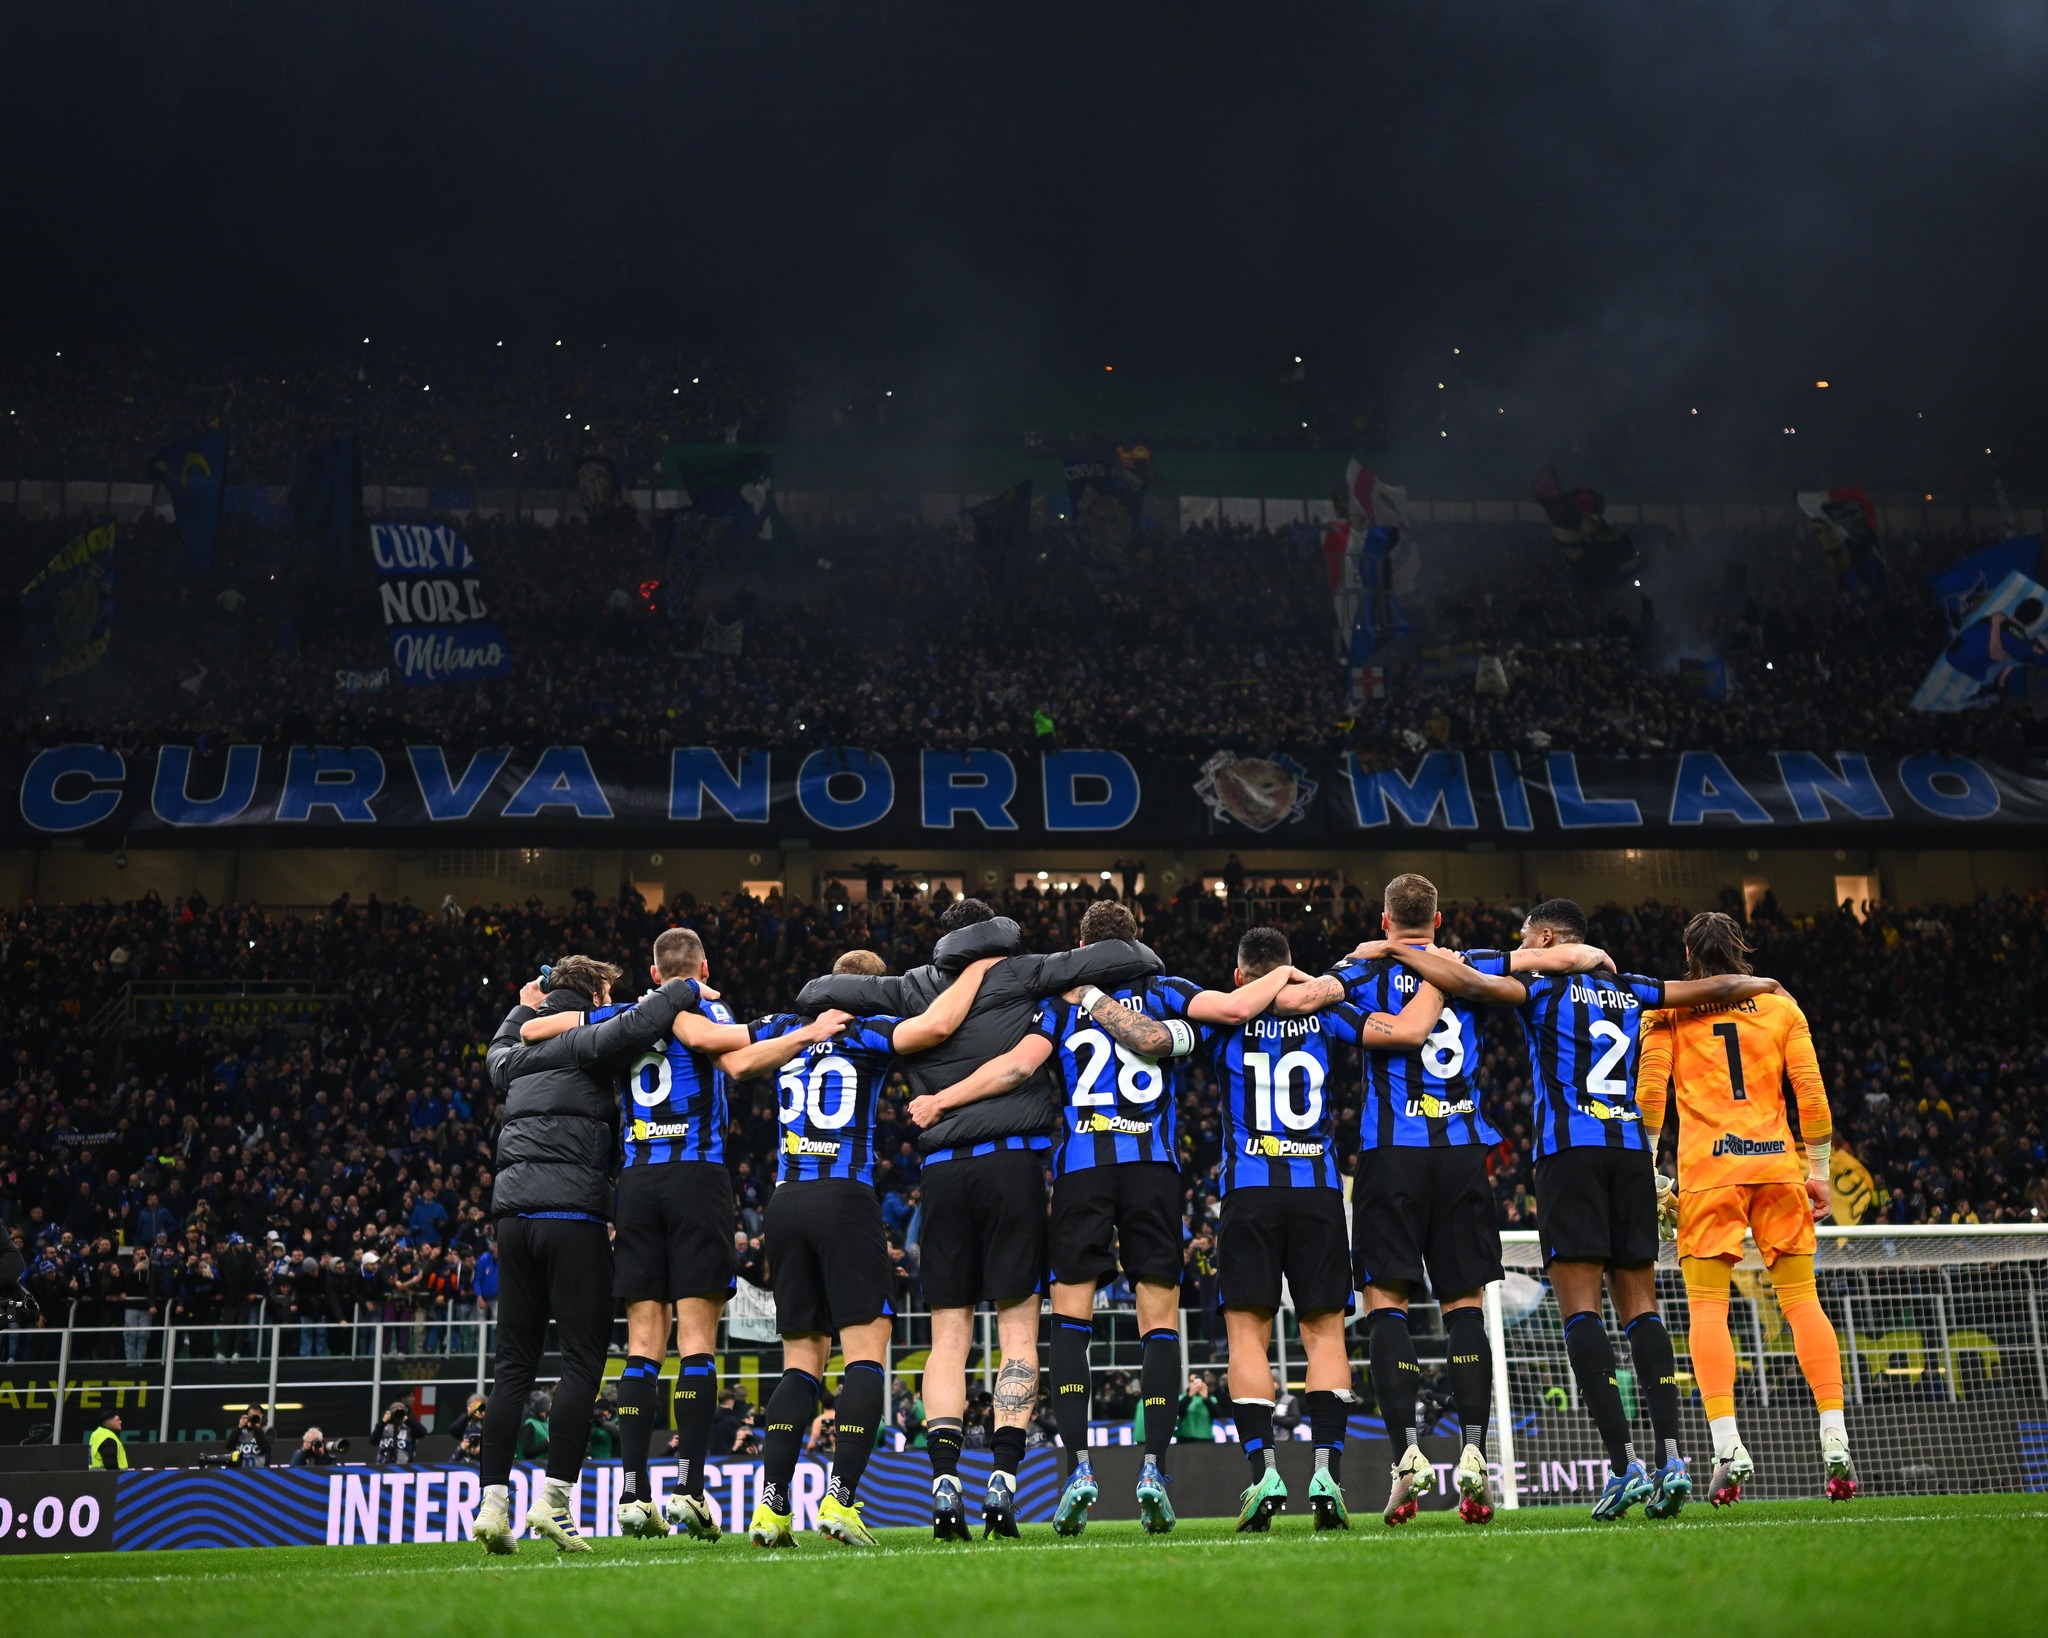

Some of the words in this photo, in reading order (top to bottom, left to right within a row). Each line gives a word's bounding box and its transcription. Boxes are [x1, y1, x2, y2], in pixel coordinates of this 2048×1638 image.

[394, 633, 506, 680] Milano
[20, 743, 614, 832] CURVA
[669, 747, 1141, 831] NORD
[1349, 750, 2001, 829] MILANO
[1244, 1015, 1321, 1039] LAUTARO
[1421, 1007, 1464, 1079] 8
[1065, 1029, 1163, 1107] 28
[1586, 1020, 1631, 1095] 2
[1713, 1023, 1747, 1100] 1
[1244, 1051, 1325, 1131] 10
[1452, 1354, 1480, 1364] INTER
[1060, 1383, 1084, 1395] INTER
[1145, 1397, 1166, 1407] INTER
[768, 1423, 794, 1432] INTER
[840, 1424, 865, 1434] INTER
